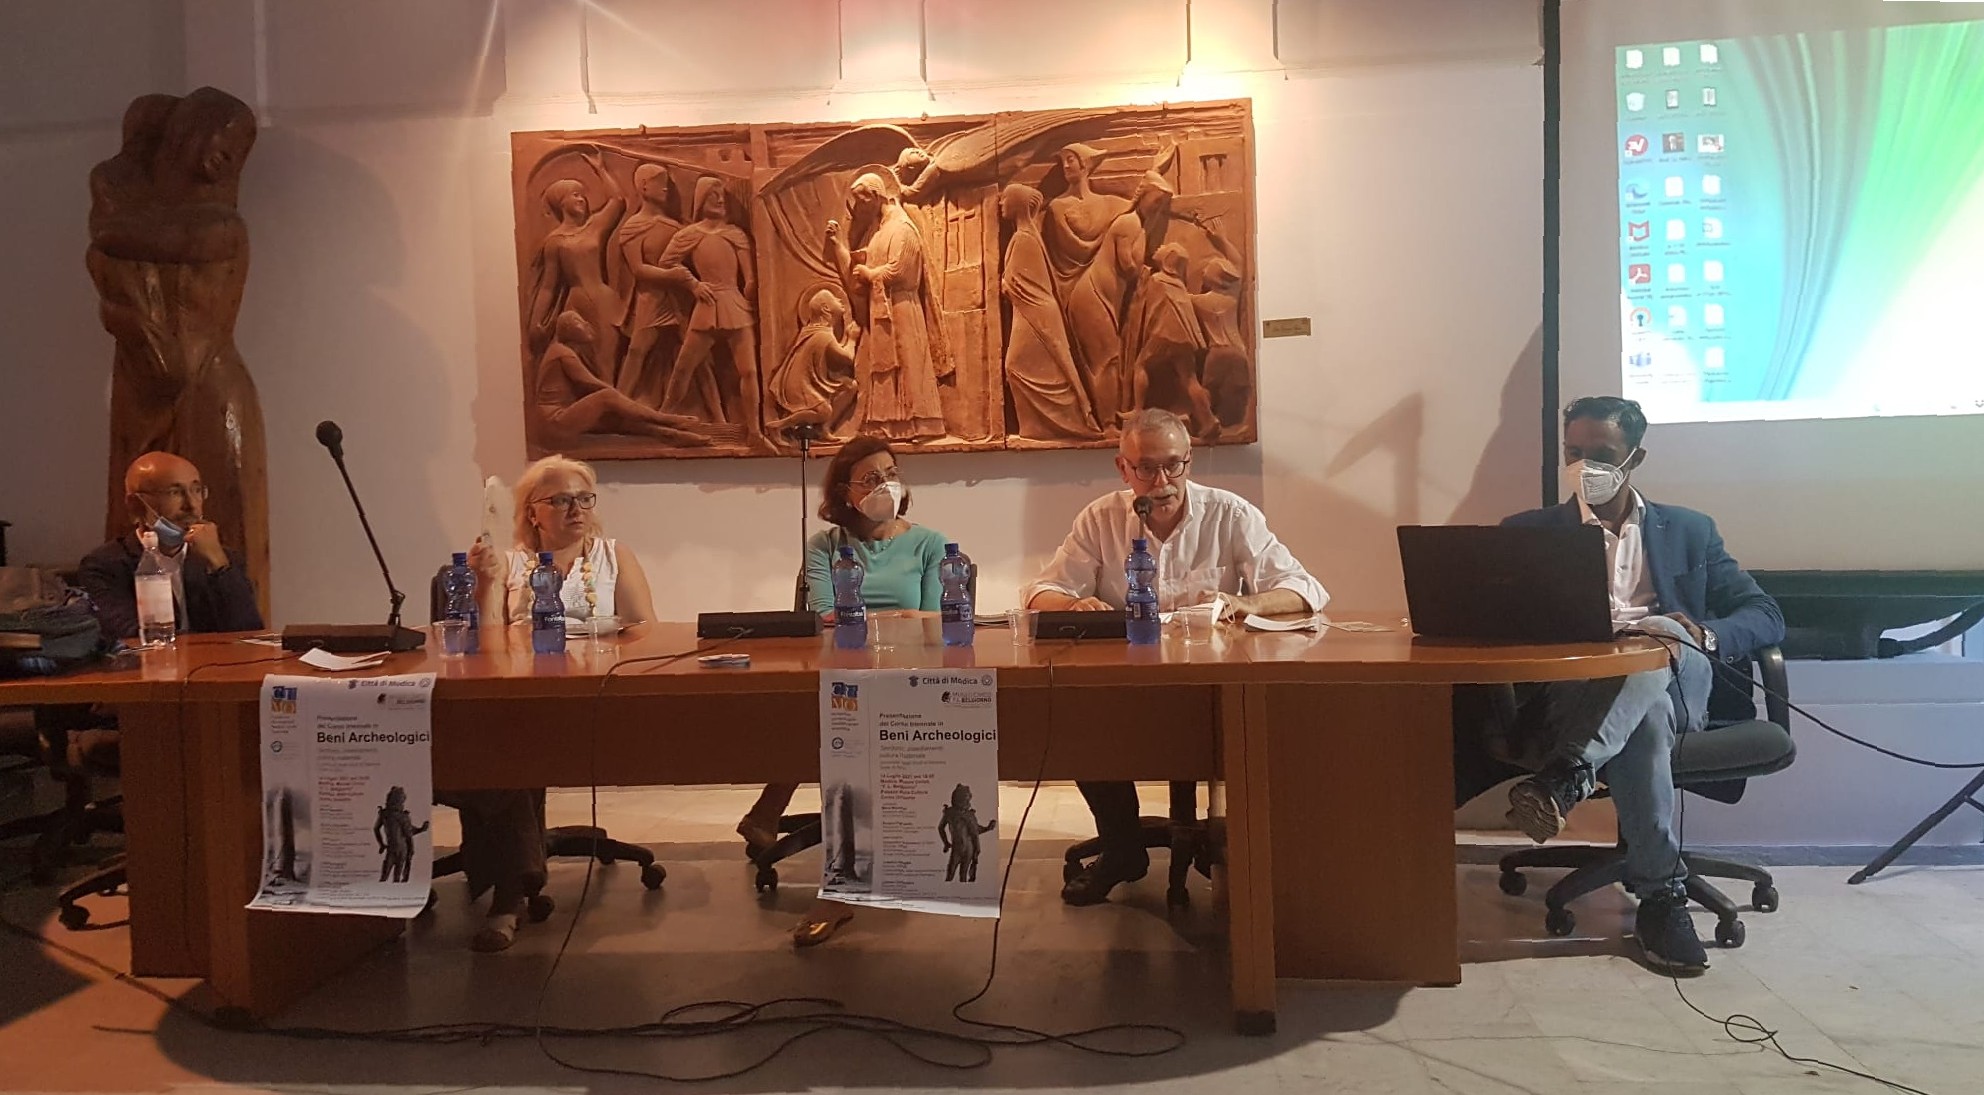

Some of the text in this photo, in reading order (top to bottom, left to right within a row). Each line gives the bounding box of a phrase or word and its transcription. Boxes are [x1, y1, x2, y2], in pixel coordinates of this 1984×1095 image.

[922, 676, 978, 685] Città di Modica
[317, 731, 430, 744] Beni Archeologici
[880, 729, 997, 744] Beni Archeologici
